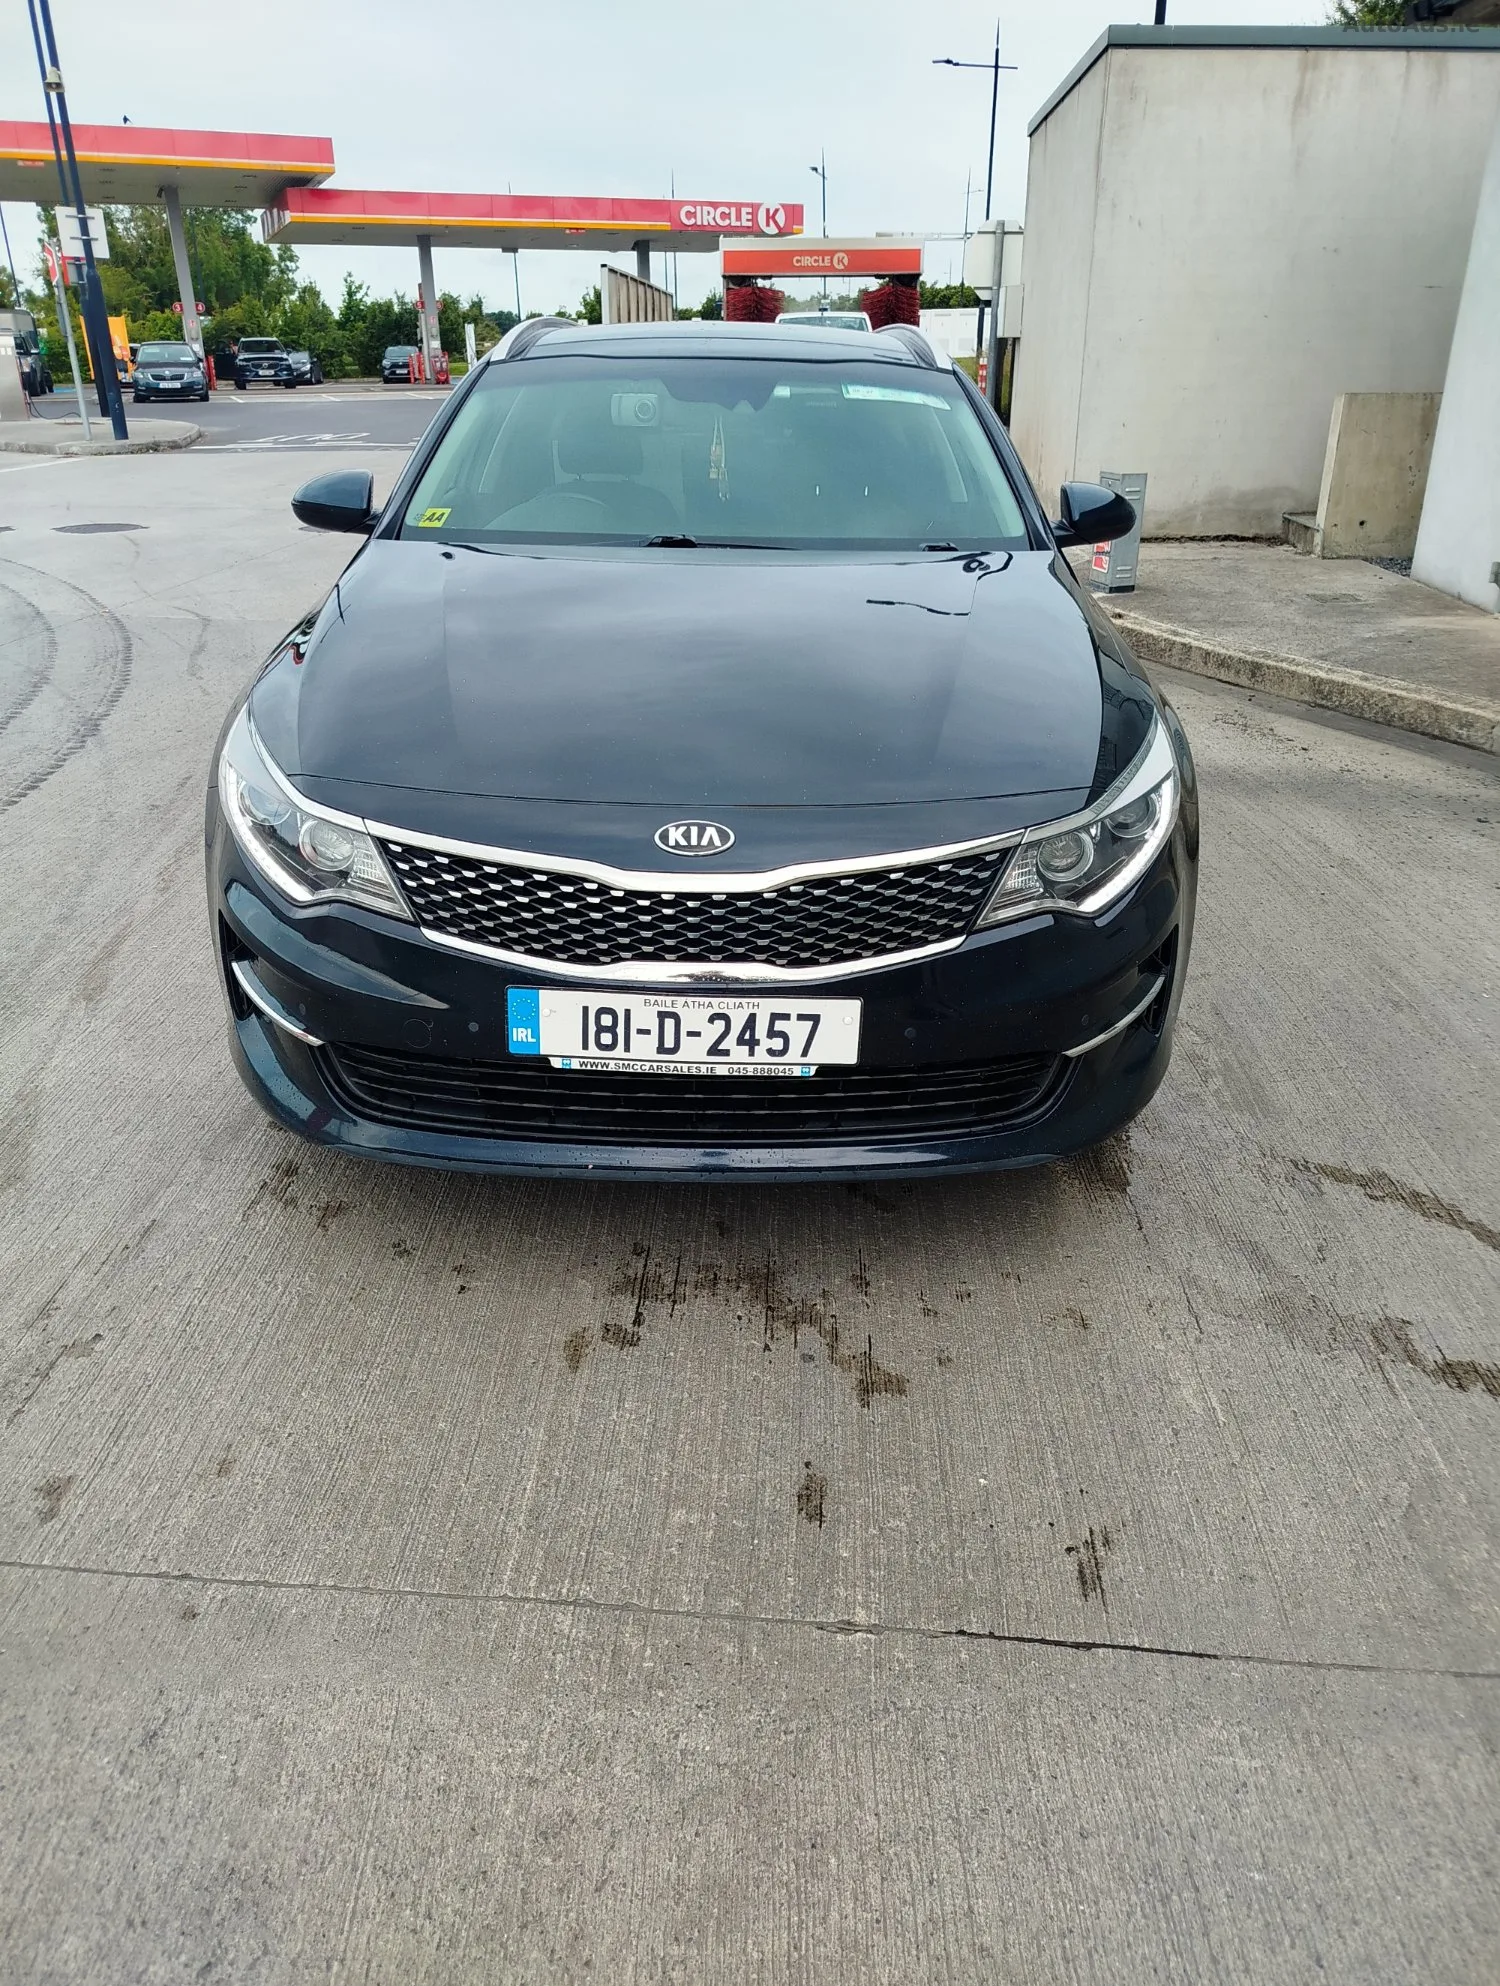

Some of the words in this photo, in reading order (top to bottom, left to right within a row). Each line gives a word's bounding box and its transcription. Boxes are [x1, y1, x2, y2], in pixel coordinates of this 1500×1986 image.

[680, 204, 753, 227] CIRCLE
[762, 205, 785, 233] K
[793, 256, 831, 267] CIRCLE
[836, 254, 848, 269] K
[422, 511, 446, 522] AA
[667, 825, 722, 847] KIA
[643, 998, 678, 1009] BAILE
[681, 998, 715, 1010] ÁTHA
[717, 1001, 760, 1010] CLIATH
[512, 1027, 537, 1043] IRL
[581, 1005, 822, 1058] 181-D-2457
[578, 1060, 717, 1075] WWW.SMCCARSALES.IE
[727, 1066, 794, 1076] 045-888045
